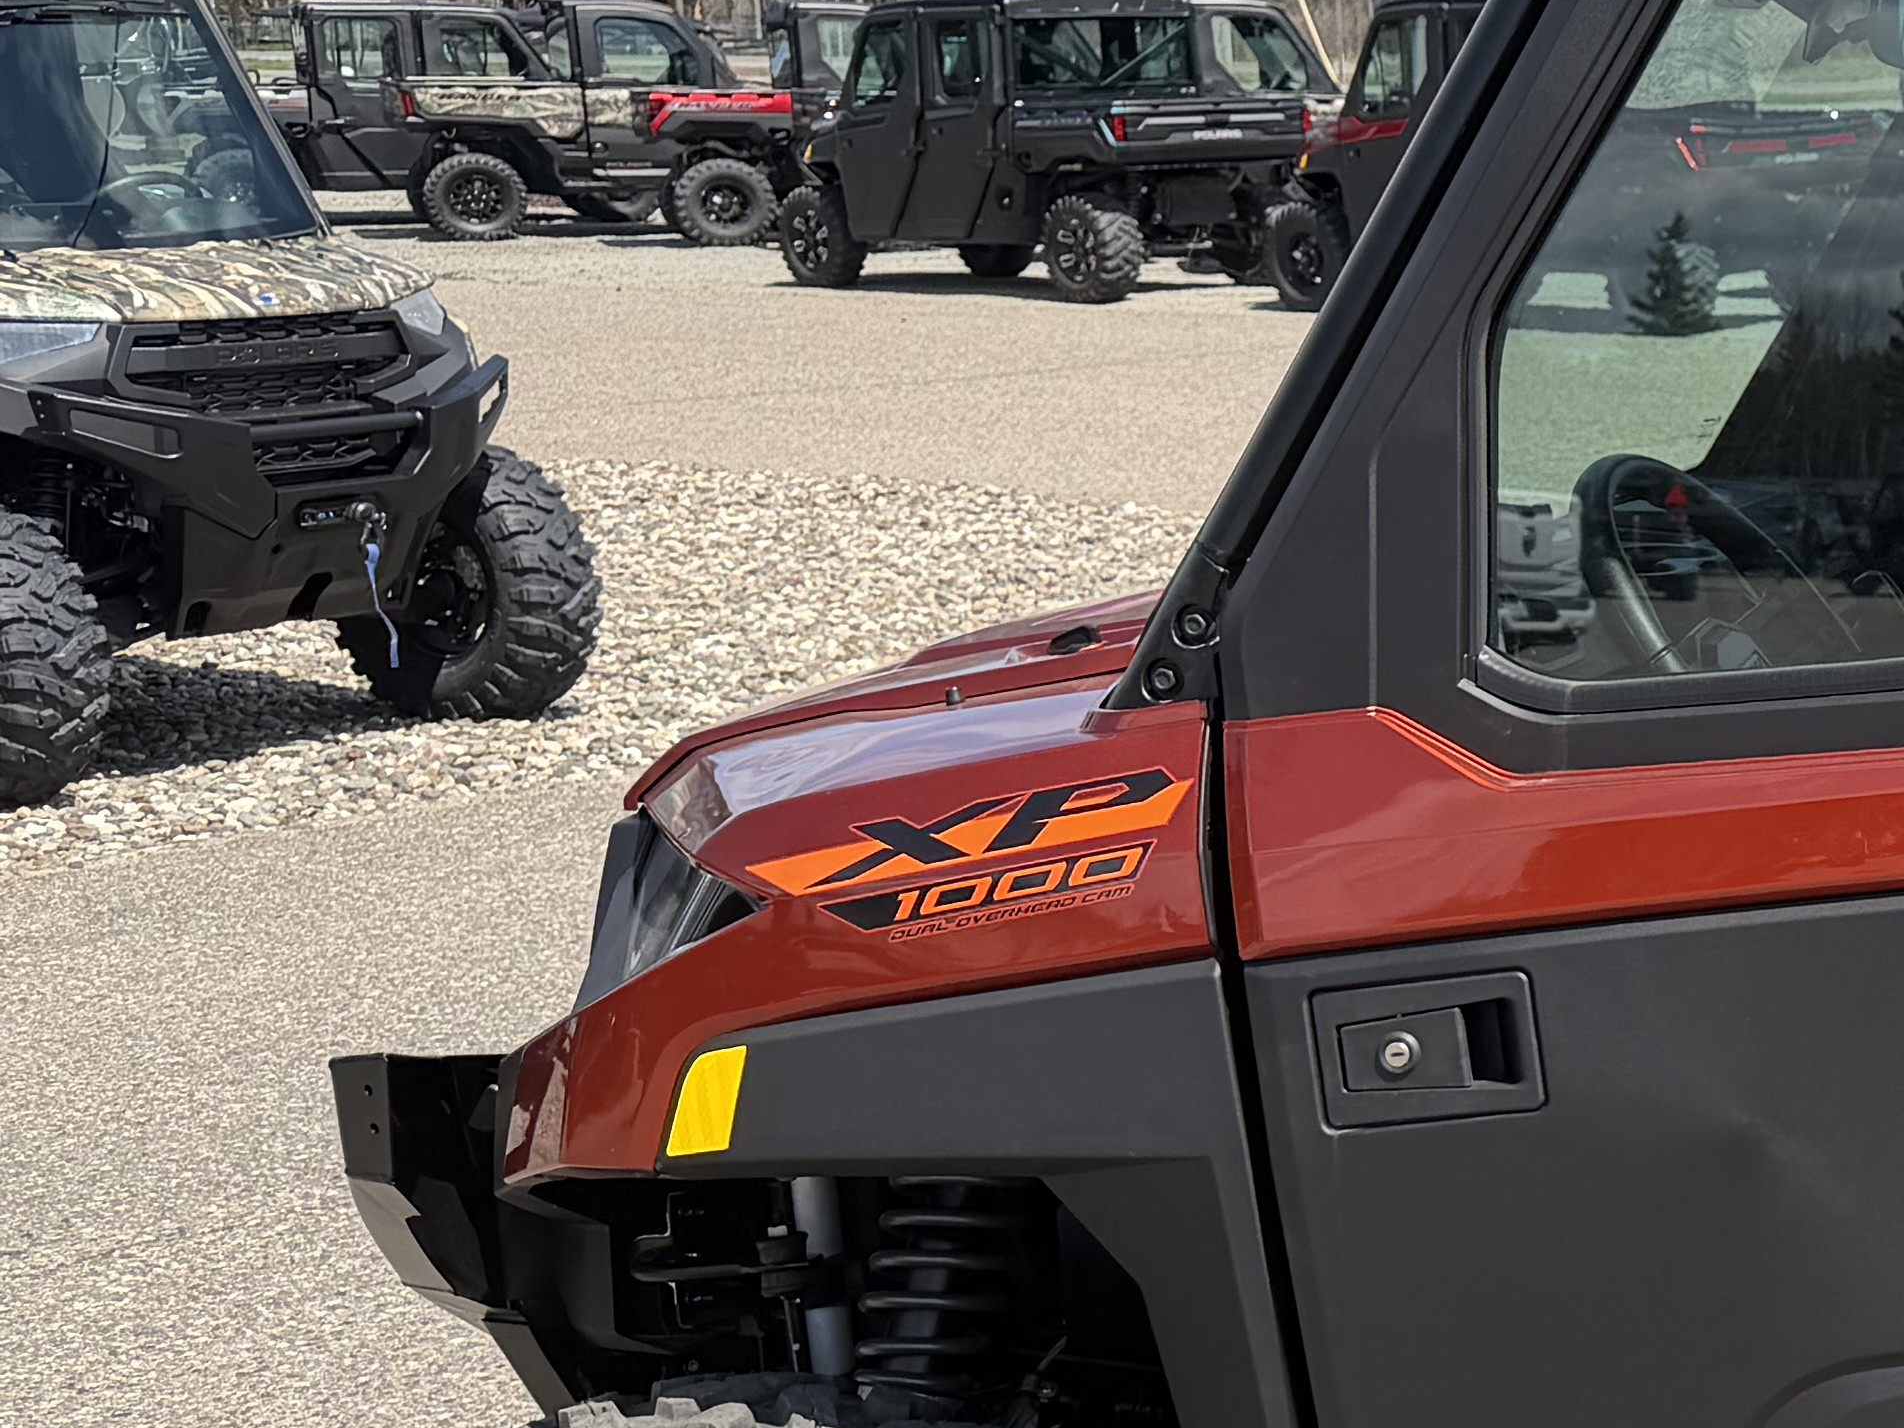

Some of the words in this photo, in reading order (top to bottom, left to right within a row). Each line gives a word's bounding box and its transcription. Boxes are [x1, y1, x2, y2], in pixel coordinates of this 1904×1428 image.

[804, 767, 1176, 890] XP
[890, 919, 950, 941] DUAL
[955, 895, 1077, 928] OVERHEAD
[1082, 884, 1132, 906] CAM
[893, 846, 1144, 922] 1000
